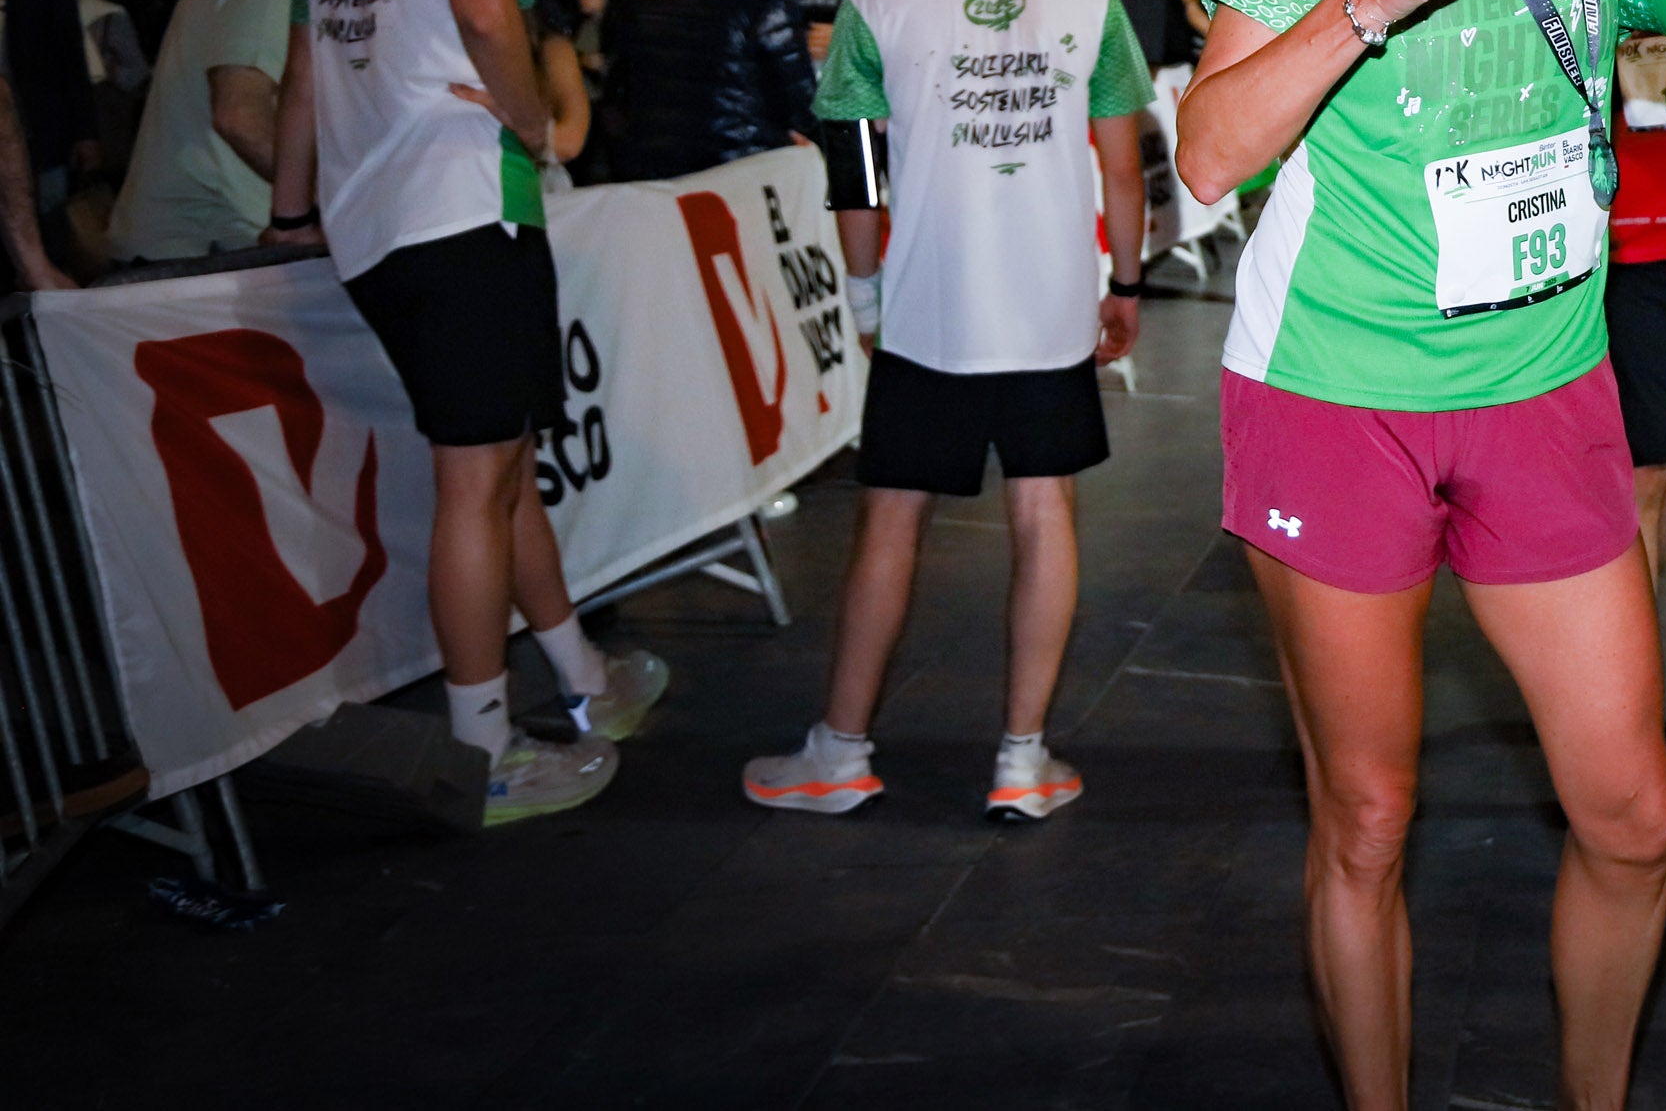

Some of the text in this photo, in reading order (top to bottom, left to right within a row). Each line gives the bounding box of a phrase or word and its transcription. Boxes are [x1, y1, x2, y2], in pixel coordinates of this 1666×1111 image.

[1542, 17, 1583, 87] FINISHER
[951, 85, 1058, 114] SOSTENIBLE
[1562, 140, 1570, 148] EL
[1562, 143, 1584, 156] DIARIO
[1563, 151, 1584, 164] VASCO
[1508, 187, 1567, 223] CRISTINA
[1512, 222, 1567, 281] F93
[1544, 277, 1557, 288] 2025
